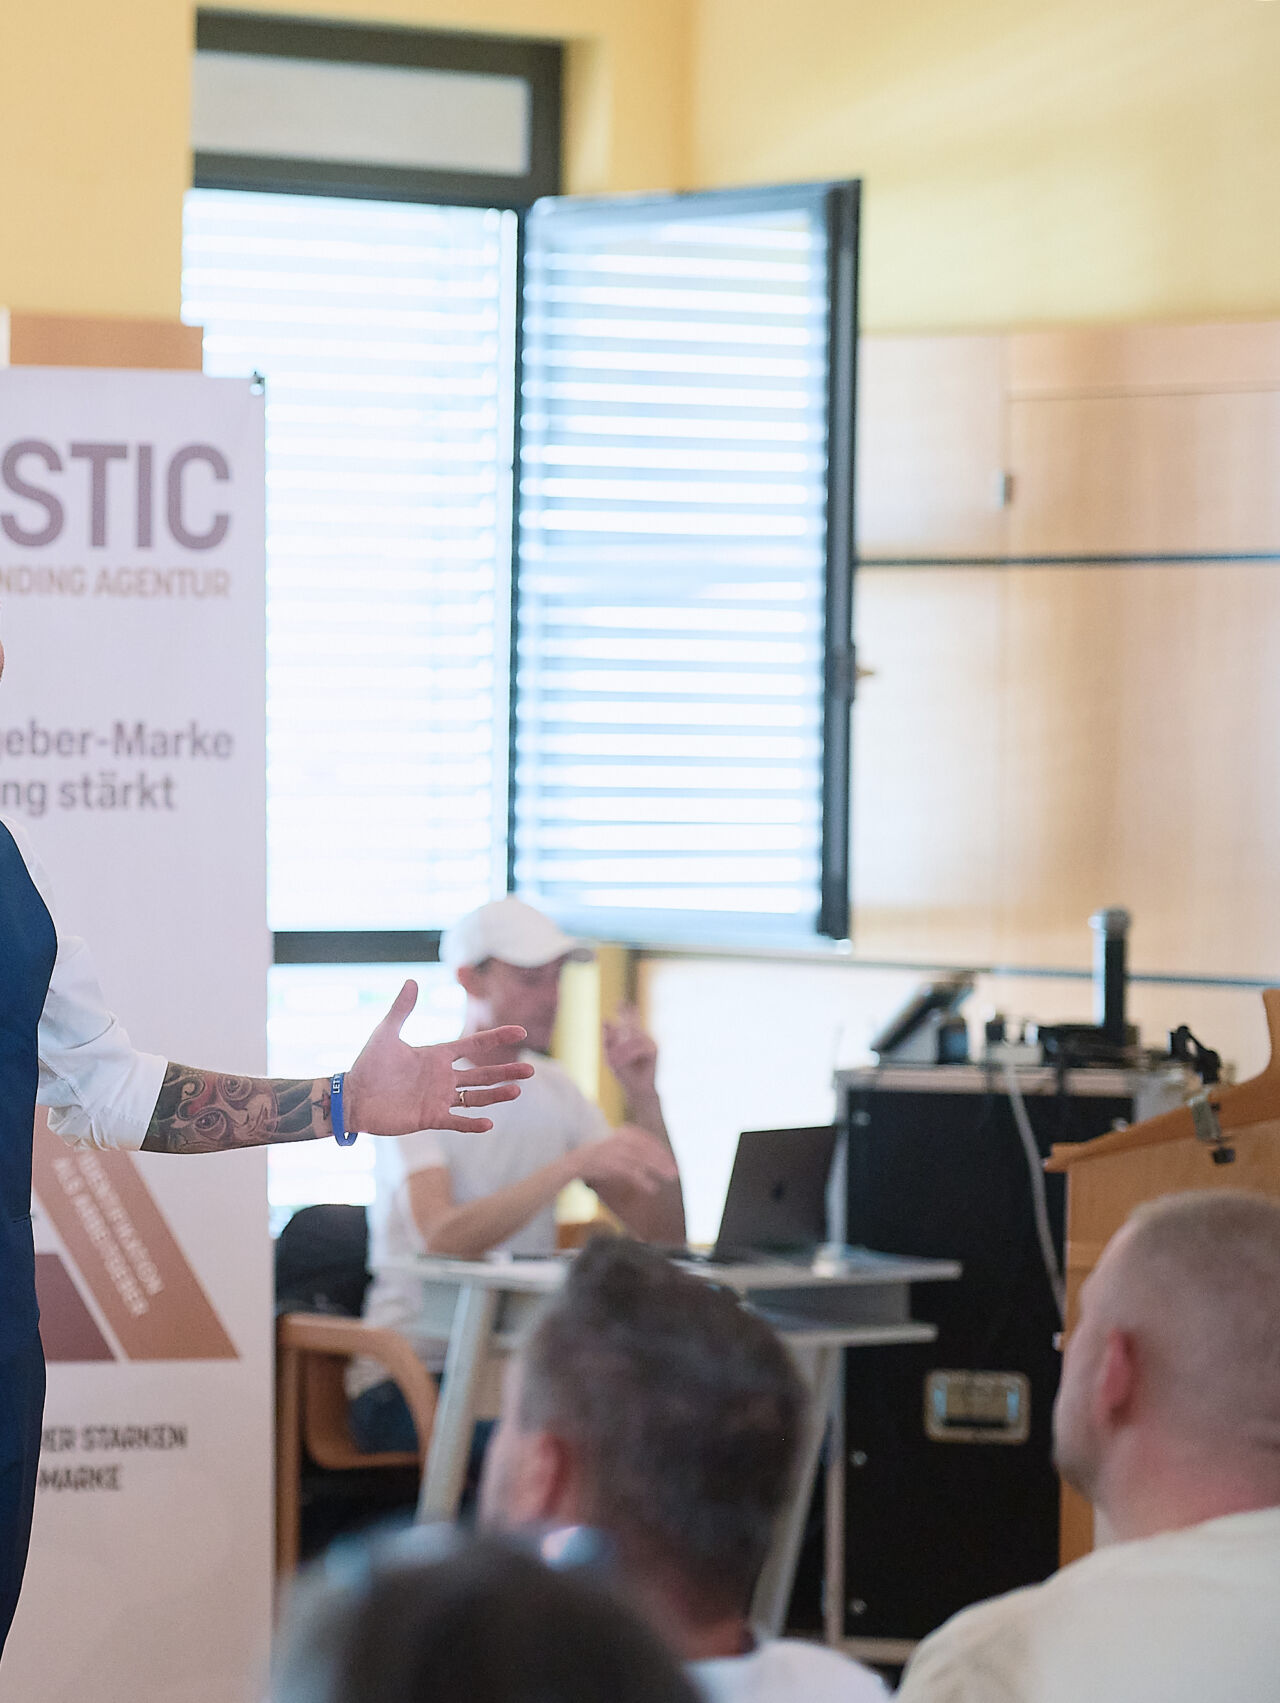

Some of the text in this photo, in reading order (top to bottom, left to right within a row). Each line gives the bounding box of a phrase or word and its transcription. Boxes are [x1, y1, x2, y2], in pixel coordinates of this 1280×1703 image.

[92, 567, 231, 597] AGENTUR
[60, 771, 176, 809] stärkt
[42, 1422, 188, 1450] ER STARKEN
